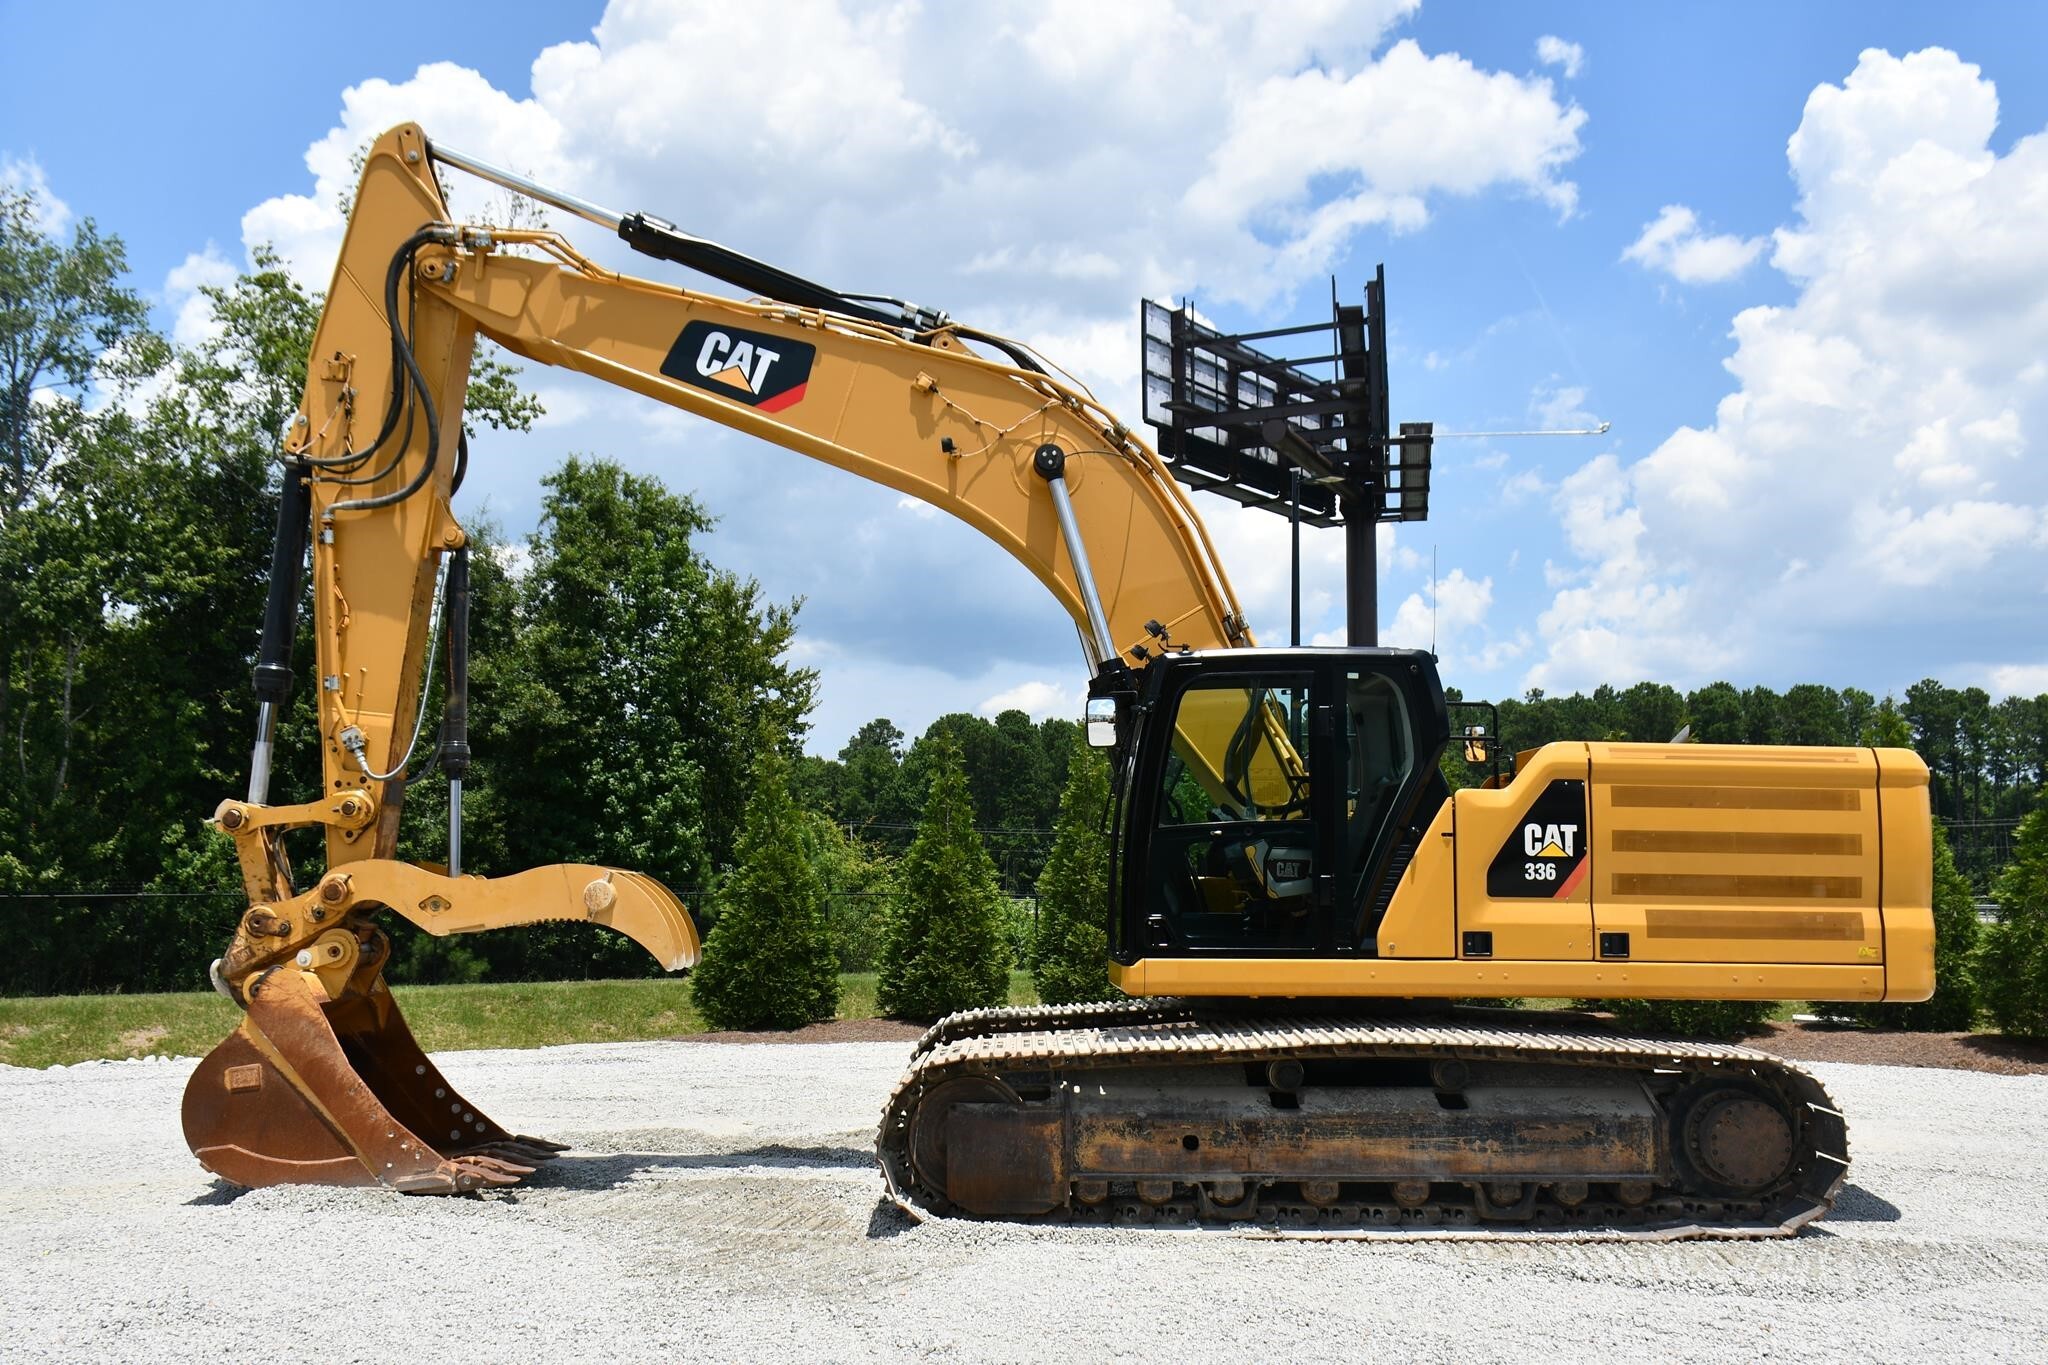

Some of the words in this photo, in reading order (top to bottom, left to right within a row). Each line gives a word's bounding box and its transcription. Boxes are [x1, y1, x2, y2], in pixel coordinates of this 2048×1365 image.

[696, 331, 780, 395] CAT
[1524, 823, 1577, 857] CAT
[1276, 862, 1300, 878] CAT
[1524, 863, 1556, 881] 336
